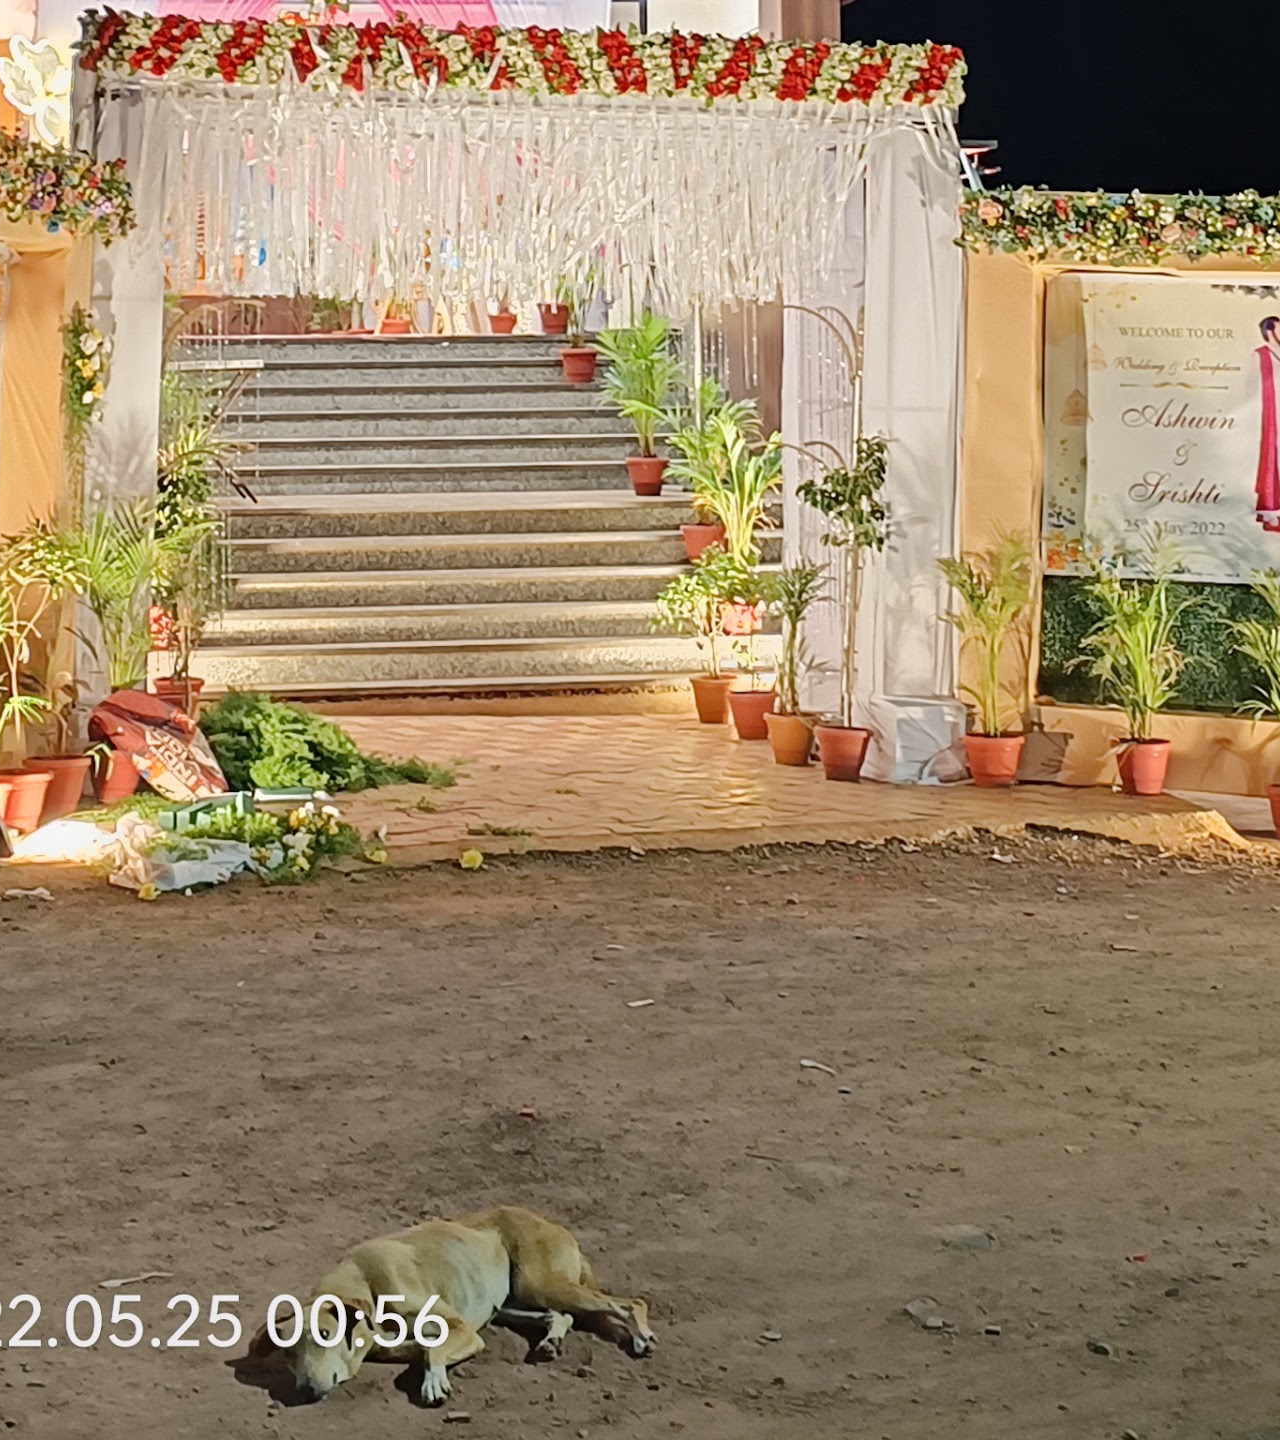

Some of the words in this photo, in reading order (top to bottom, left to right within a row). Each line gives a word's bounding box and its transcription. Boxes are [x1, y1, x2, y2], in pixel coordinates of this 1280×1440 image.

[1118, 326, 1184, 338] WELCOME
[1186, 327, 1205, 339] TO
[1206, 328, 1235, 340] OUR
[1121, 398, 1237, 430] Ashwin
[1173, 439, 1199, 467] &
[1128, 470, 1225, 505] Srishti
[1190, 520, 1226, 536] 2022
